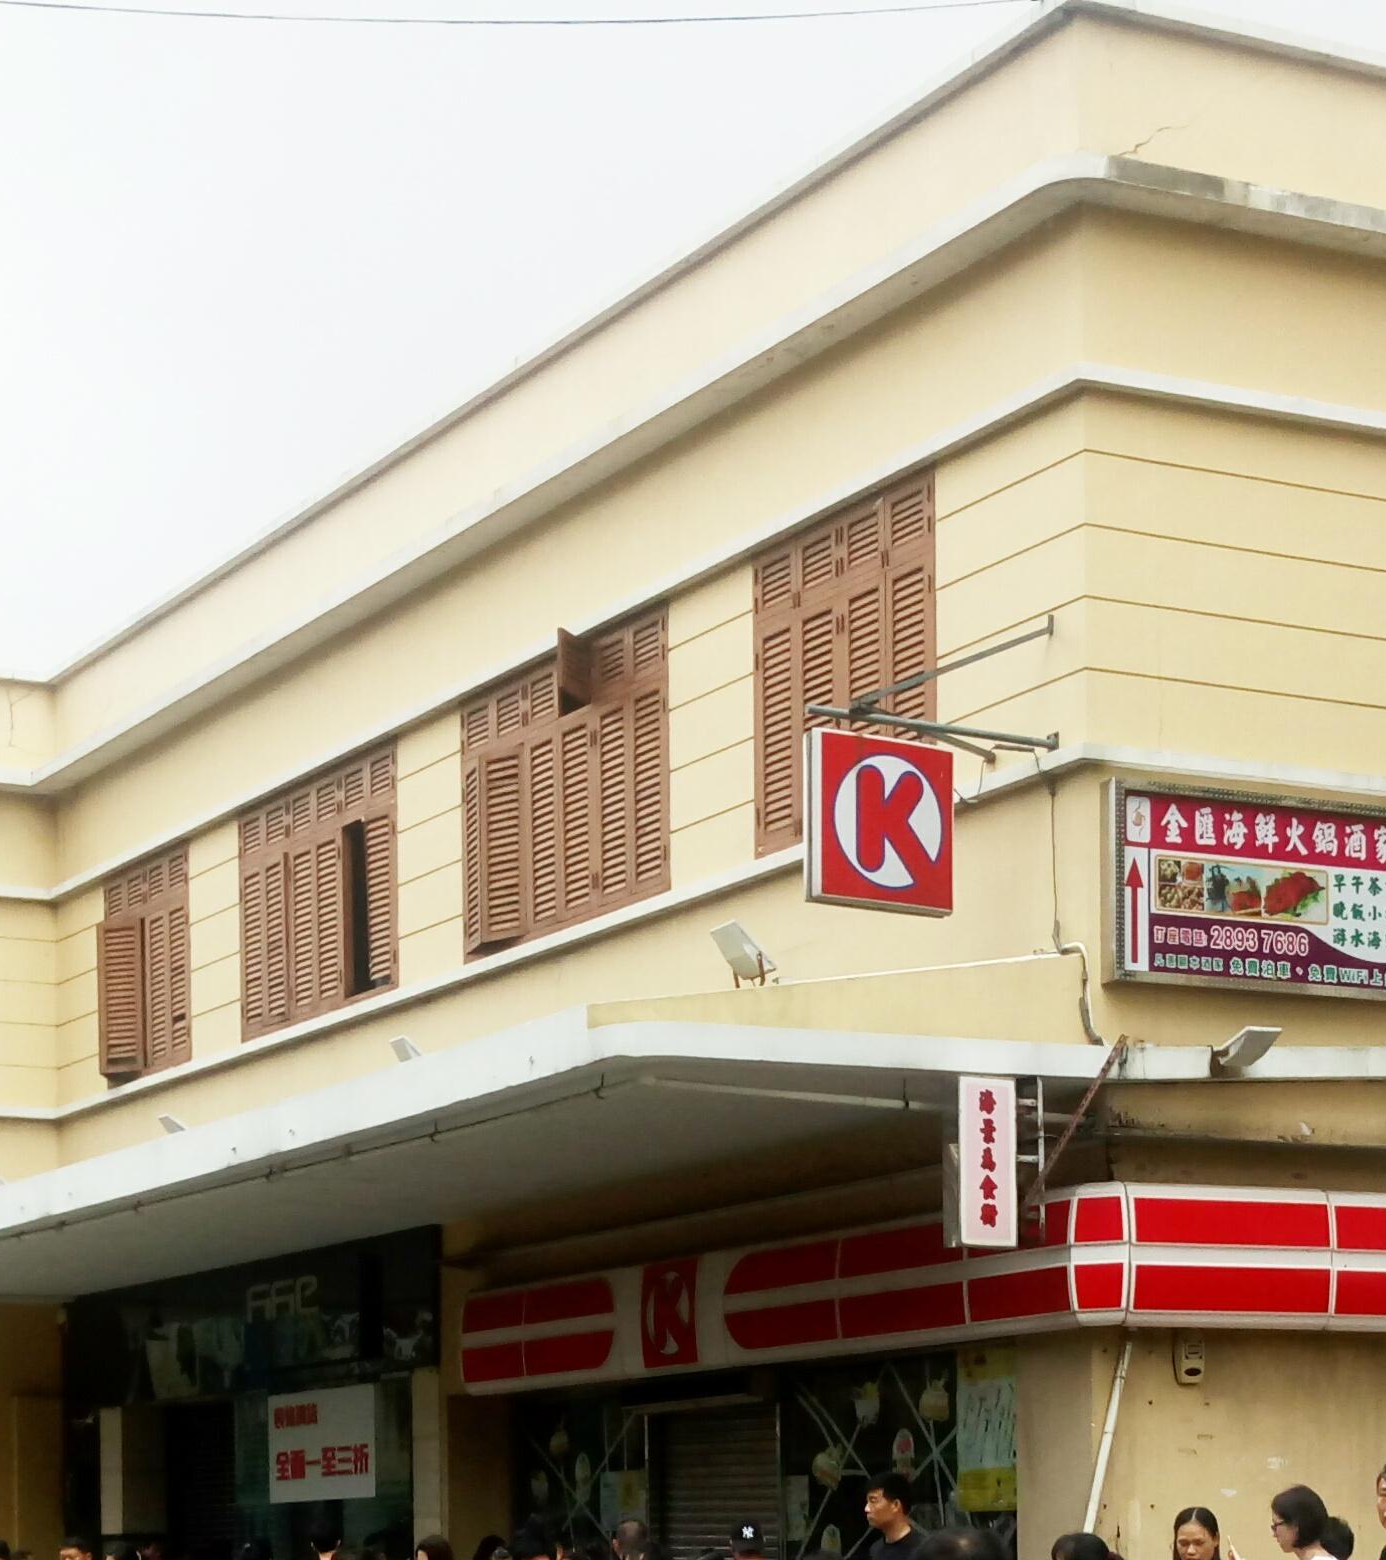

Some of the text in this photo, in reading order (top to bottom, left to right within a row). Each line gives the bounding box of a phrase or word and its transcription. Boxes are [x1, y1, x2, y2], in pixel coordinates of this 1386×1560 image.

[851, 760, 941, 888] K
[1210, 924, 1259, 954] 2893
[1261, 929, 1309, 957] 7686
[651, 1273, 690, 1357] K
